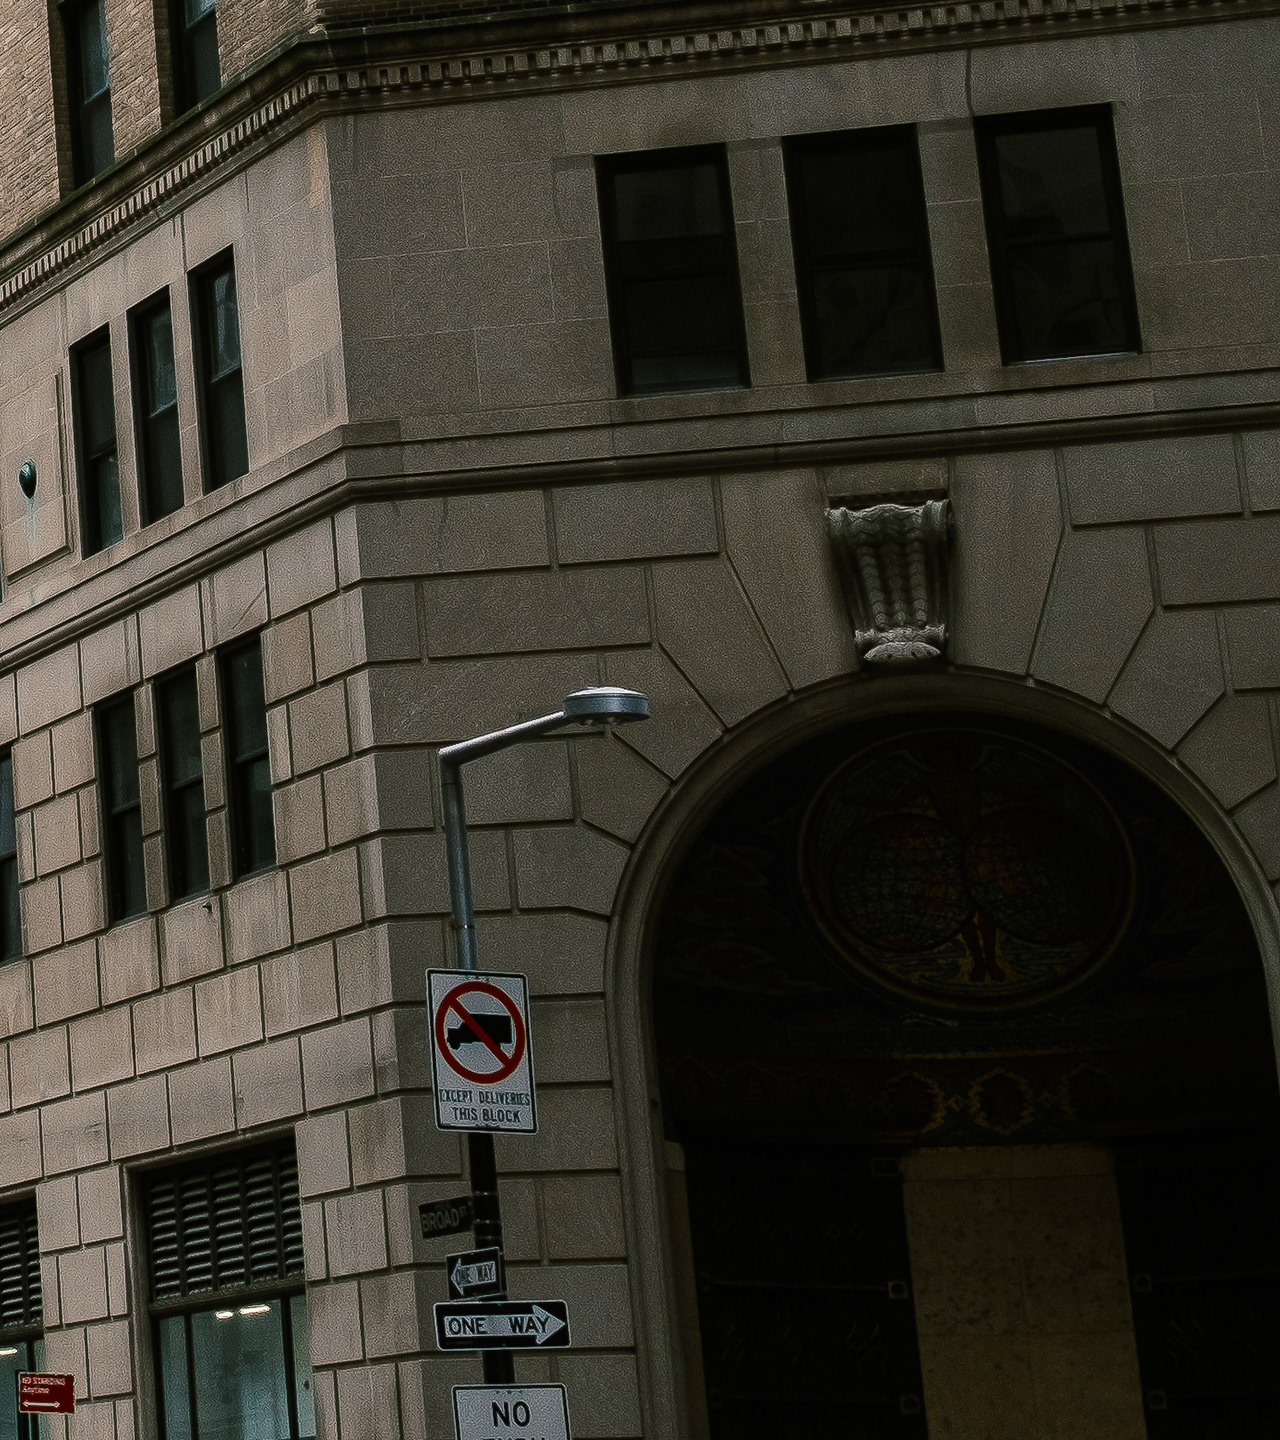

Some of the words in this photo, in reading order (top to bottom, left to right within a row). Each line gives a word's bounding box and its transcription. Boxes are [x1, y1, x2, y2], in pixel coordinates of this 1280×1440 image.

[440, 1089, 473, 1103] EXCEPT
[478, 1090, 530, 1106] DELIVERIES
[452, 1106, 478, 1121] THIS
[482, 1108, 521, 1123] BLOCK
[421, 1208, 459, 1232] BROAD
[448, 1317, 489, 1336] ONE
[509, 1316, 550, 1334] WAY
[492, 1401, 531, 1427] NO
